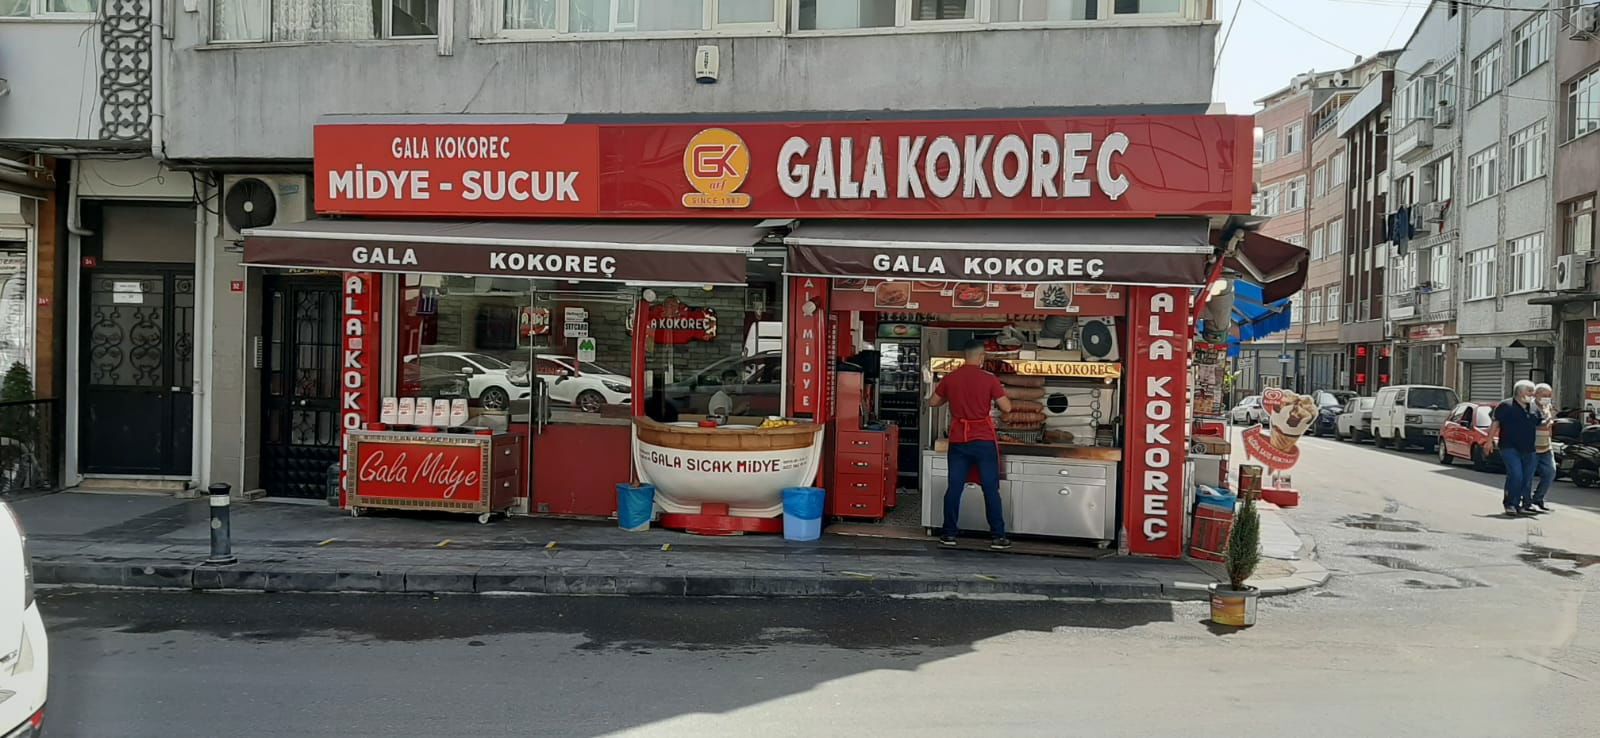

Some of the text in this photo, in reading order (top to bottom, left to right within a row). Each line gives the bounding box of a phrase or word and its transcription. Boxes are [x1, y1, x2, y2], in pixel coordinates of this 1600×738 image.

[391, 136, 429, 159] GALA
[692, 144, 741, 179] GK
[328, 163, 430, 200] MİDYE
[462, 170, 580, 202] SUCUK
[776, 132, 1130, 201] GALA KOKOREÇ
[352, 246, 617, 278] GALA KOKOREÇ
[873, 254, 1104, 279] GALA KOKOREÇ
[1024, 362, 1054, 374] GALA
[359, 450, 479, 499] Gala Midye
[651, 450, 682, 469] GALA
[686, 458, 733, 473] SICAK
[1142, 376, 1173, 541] KOKOREÇ
